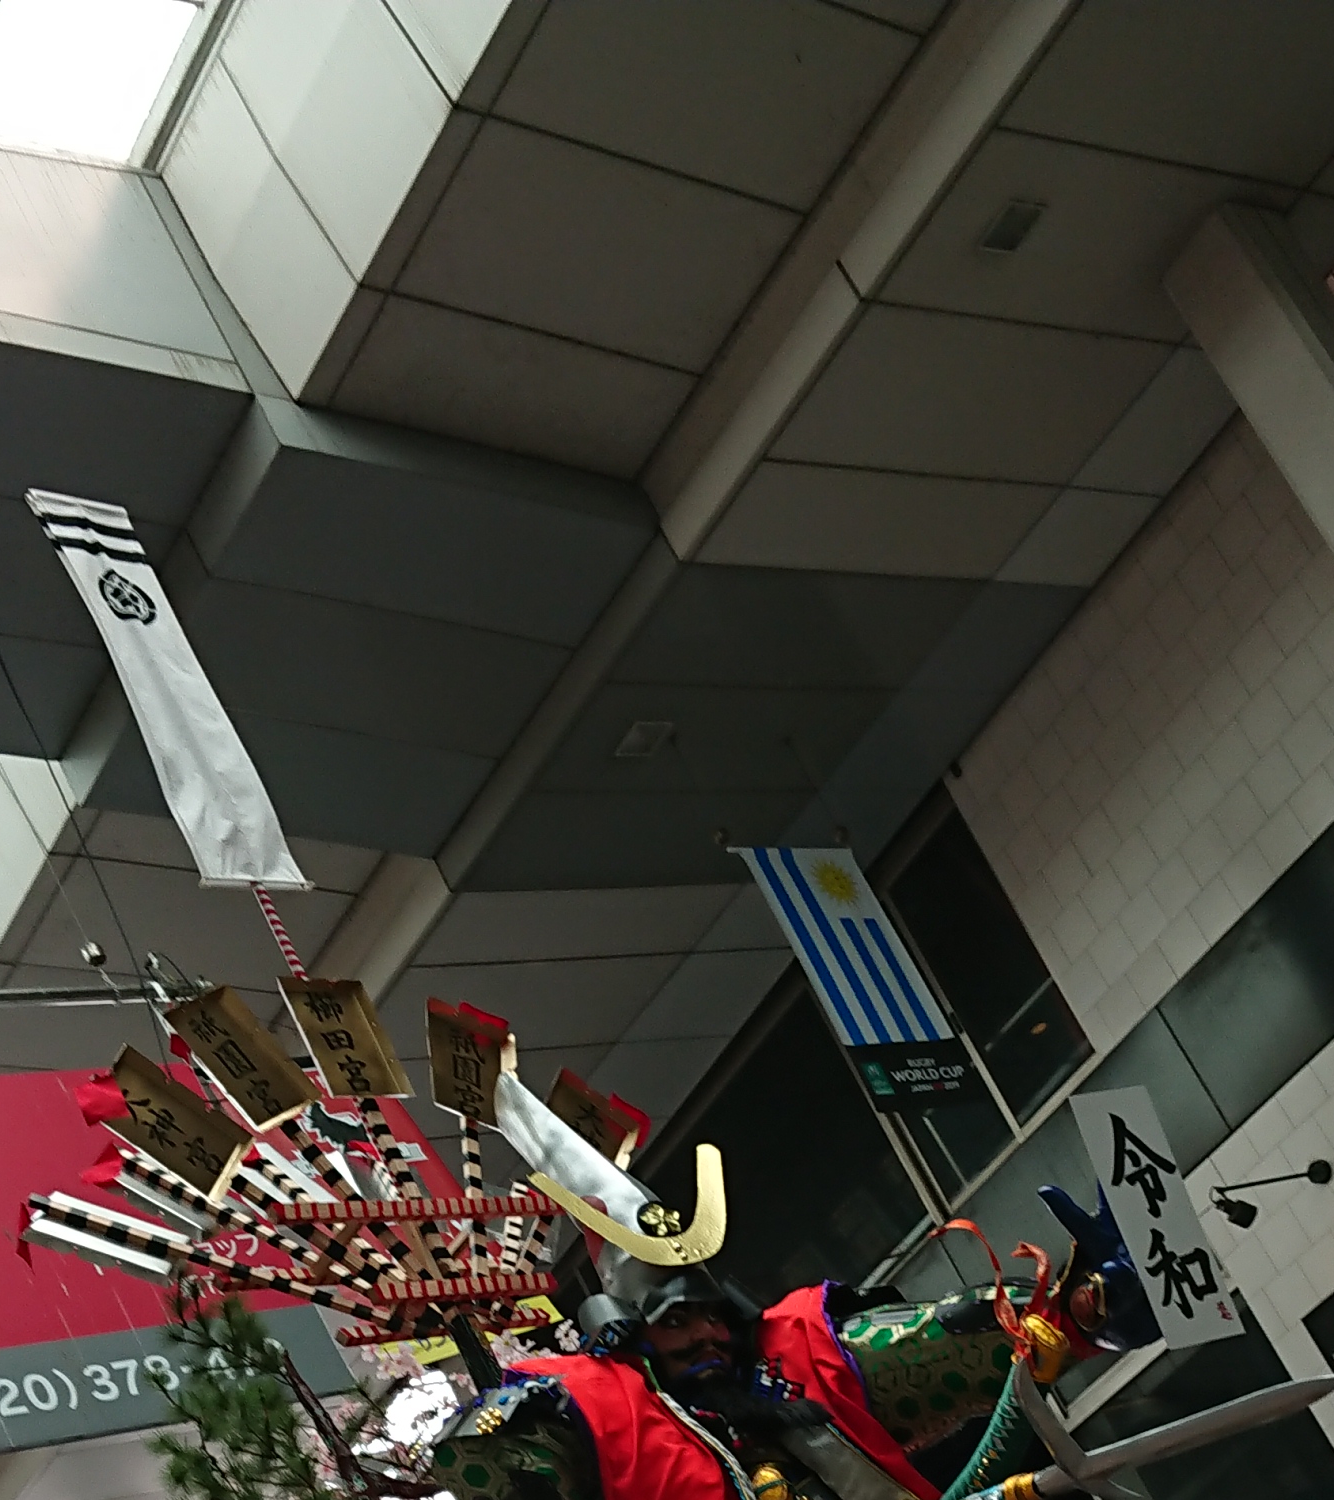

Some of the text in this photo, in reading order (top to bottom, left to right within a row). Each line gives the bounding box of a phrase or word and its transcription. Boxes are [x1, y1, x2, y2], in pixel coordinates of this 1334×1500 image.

[890, 1067, 940, 1083] WORLD
[938, 1064, 965, 1079] CUP
[1108, 1112, 1218, 1319] 令和
